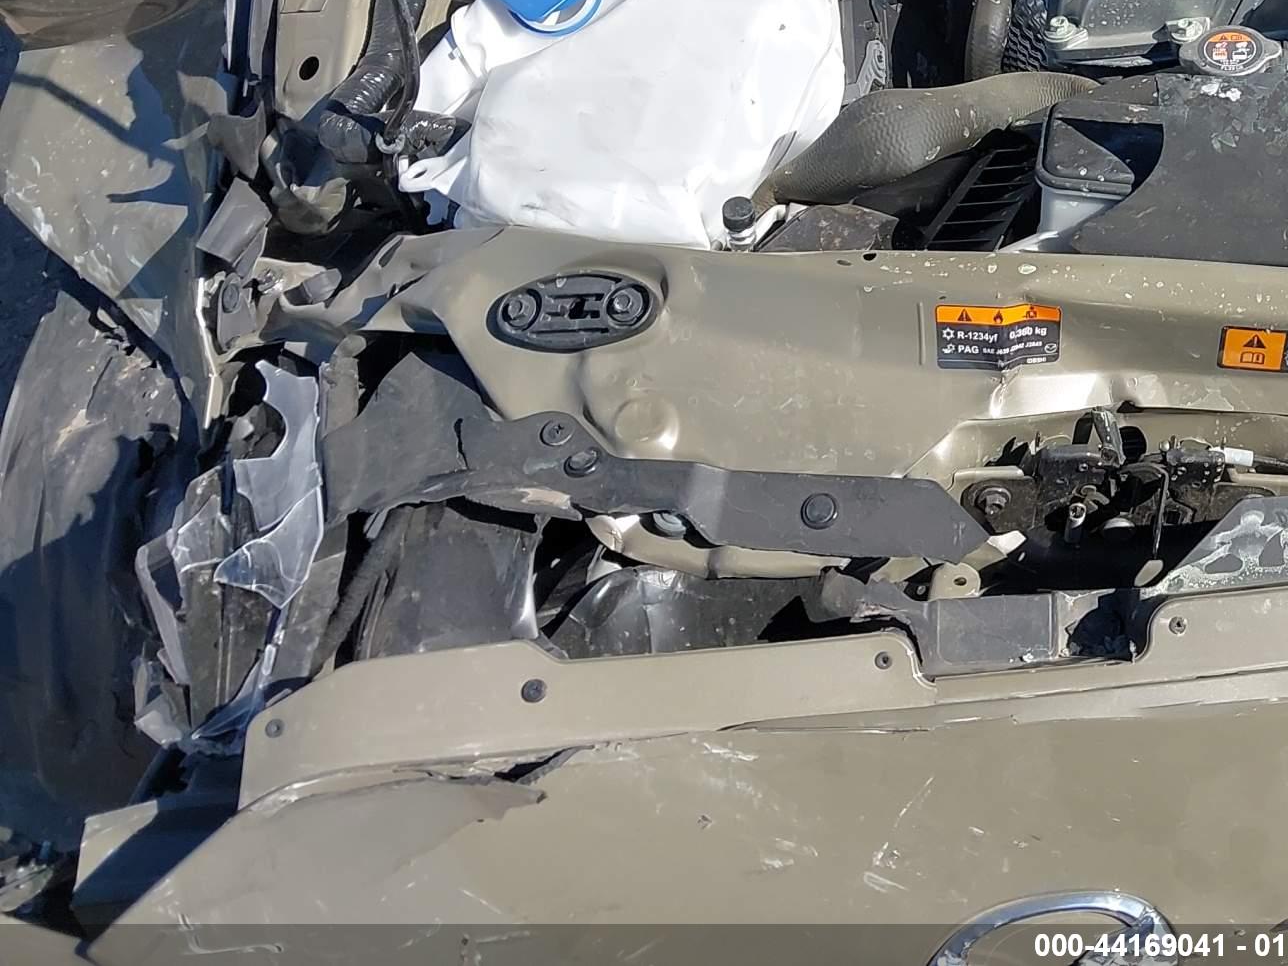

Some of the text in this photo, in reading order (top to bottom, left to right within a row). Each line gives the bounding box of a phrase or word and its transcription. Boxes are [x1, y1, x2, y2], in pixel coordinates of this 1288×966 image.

[957, 331, 998, 343] R-1234yf
[1034, 326, 1047, 336] kg
[958, 345, 979, 354] PAG
